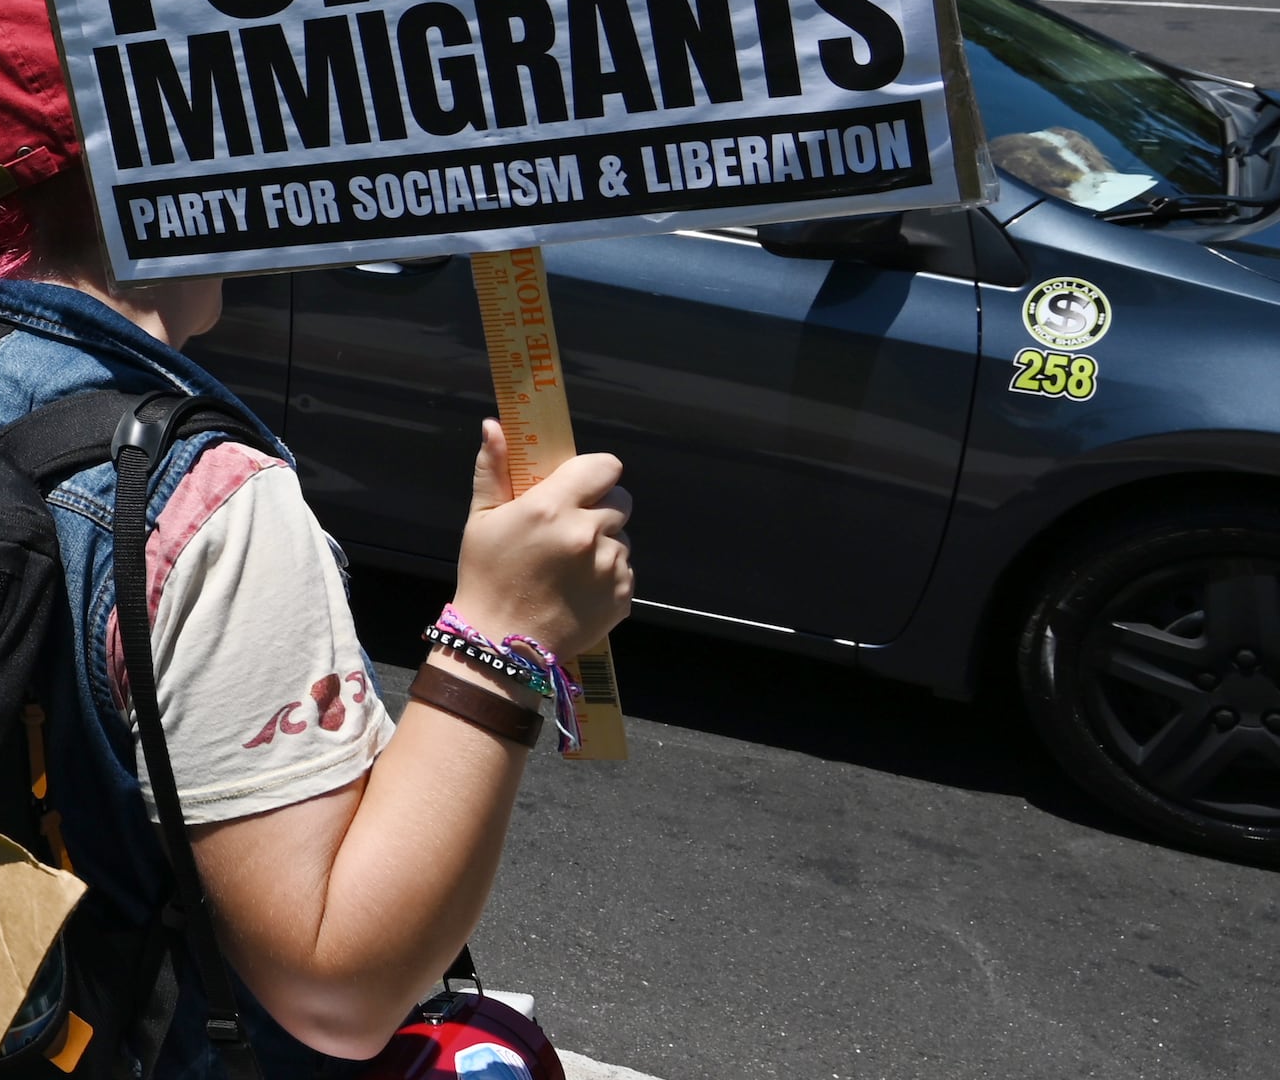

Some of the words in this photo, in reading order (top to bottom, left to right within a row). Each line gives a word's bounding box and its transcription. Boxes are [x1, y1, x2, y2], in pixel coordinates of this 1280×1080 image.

[128, 185, 249, 243] PARTY
[261, 176, 341, 229] FOR
[350, 154, 584, 221] SOCIALISM
[599, 152, 630, 198] &
[642, 117, 914, 193] LIBERATION
[494, 269, 508, 284] 12
[1042, 282, 1098, 299] DOLLAR
[1033, 324, 1055, 343] RIDE
[1055, 333, 1093, 345] SHARE
[510, 352, 523, 368] 10
[526, 335, 557, 392] THE
[1013, 349, 1096, 399] 258
[430, 631, 503, 670] DEFEND
